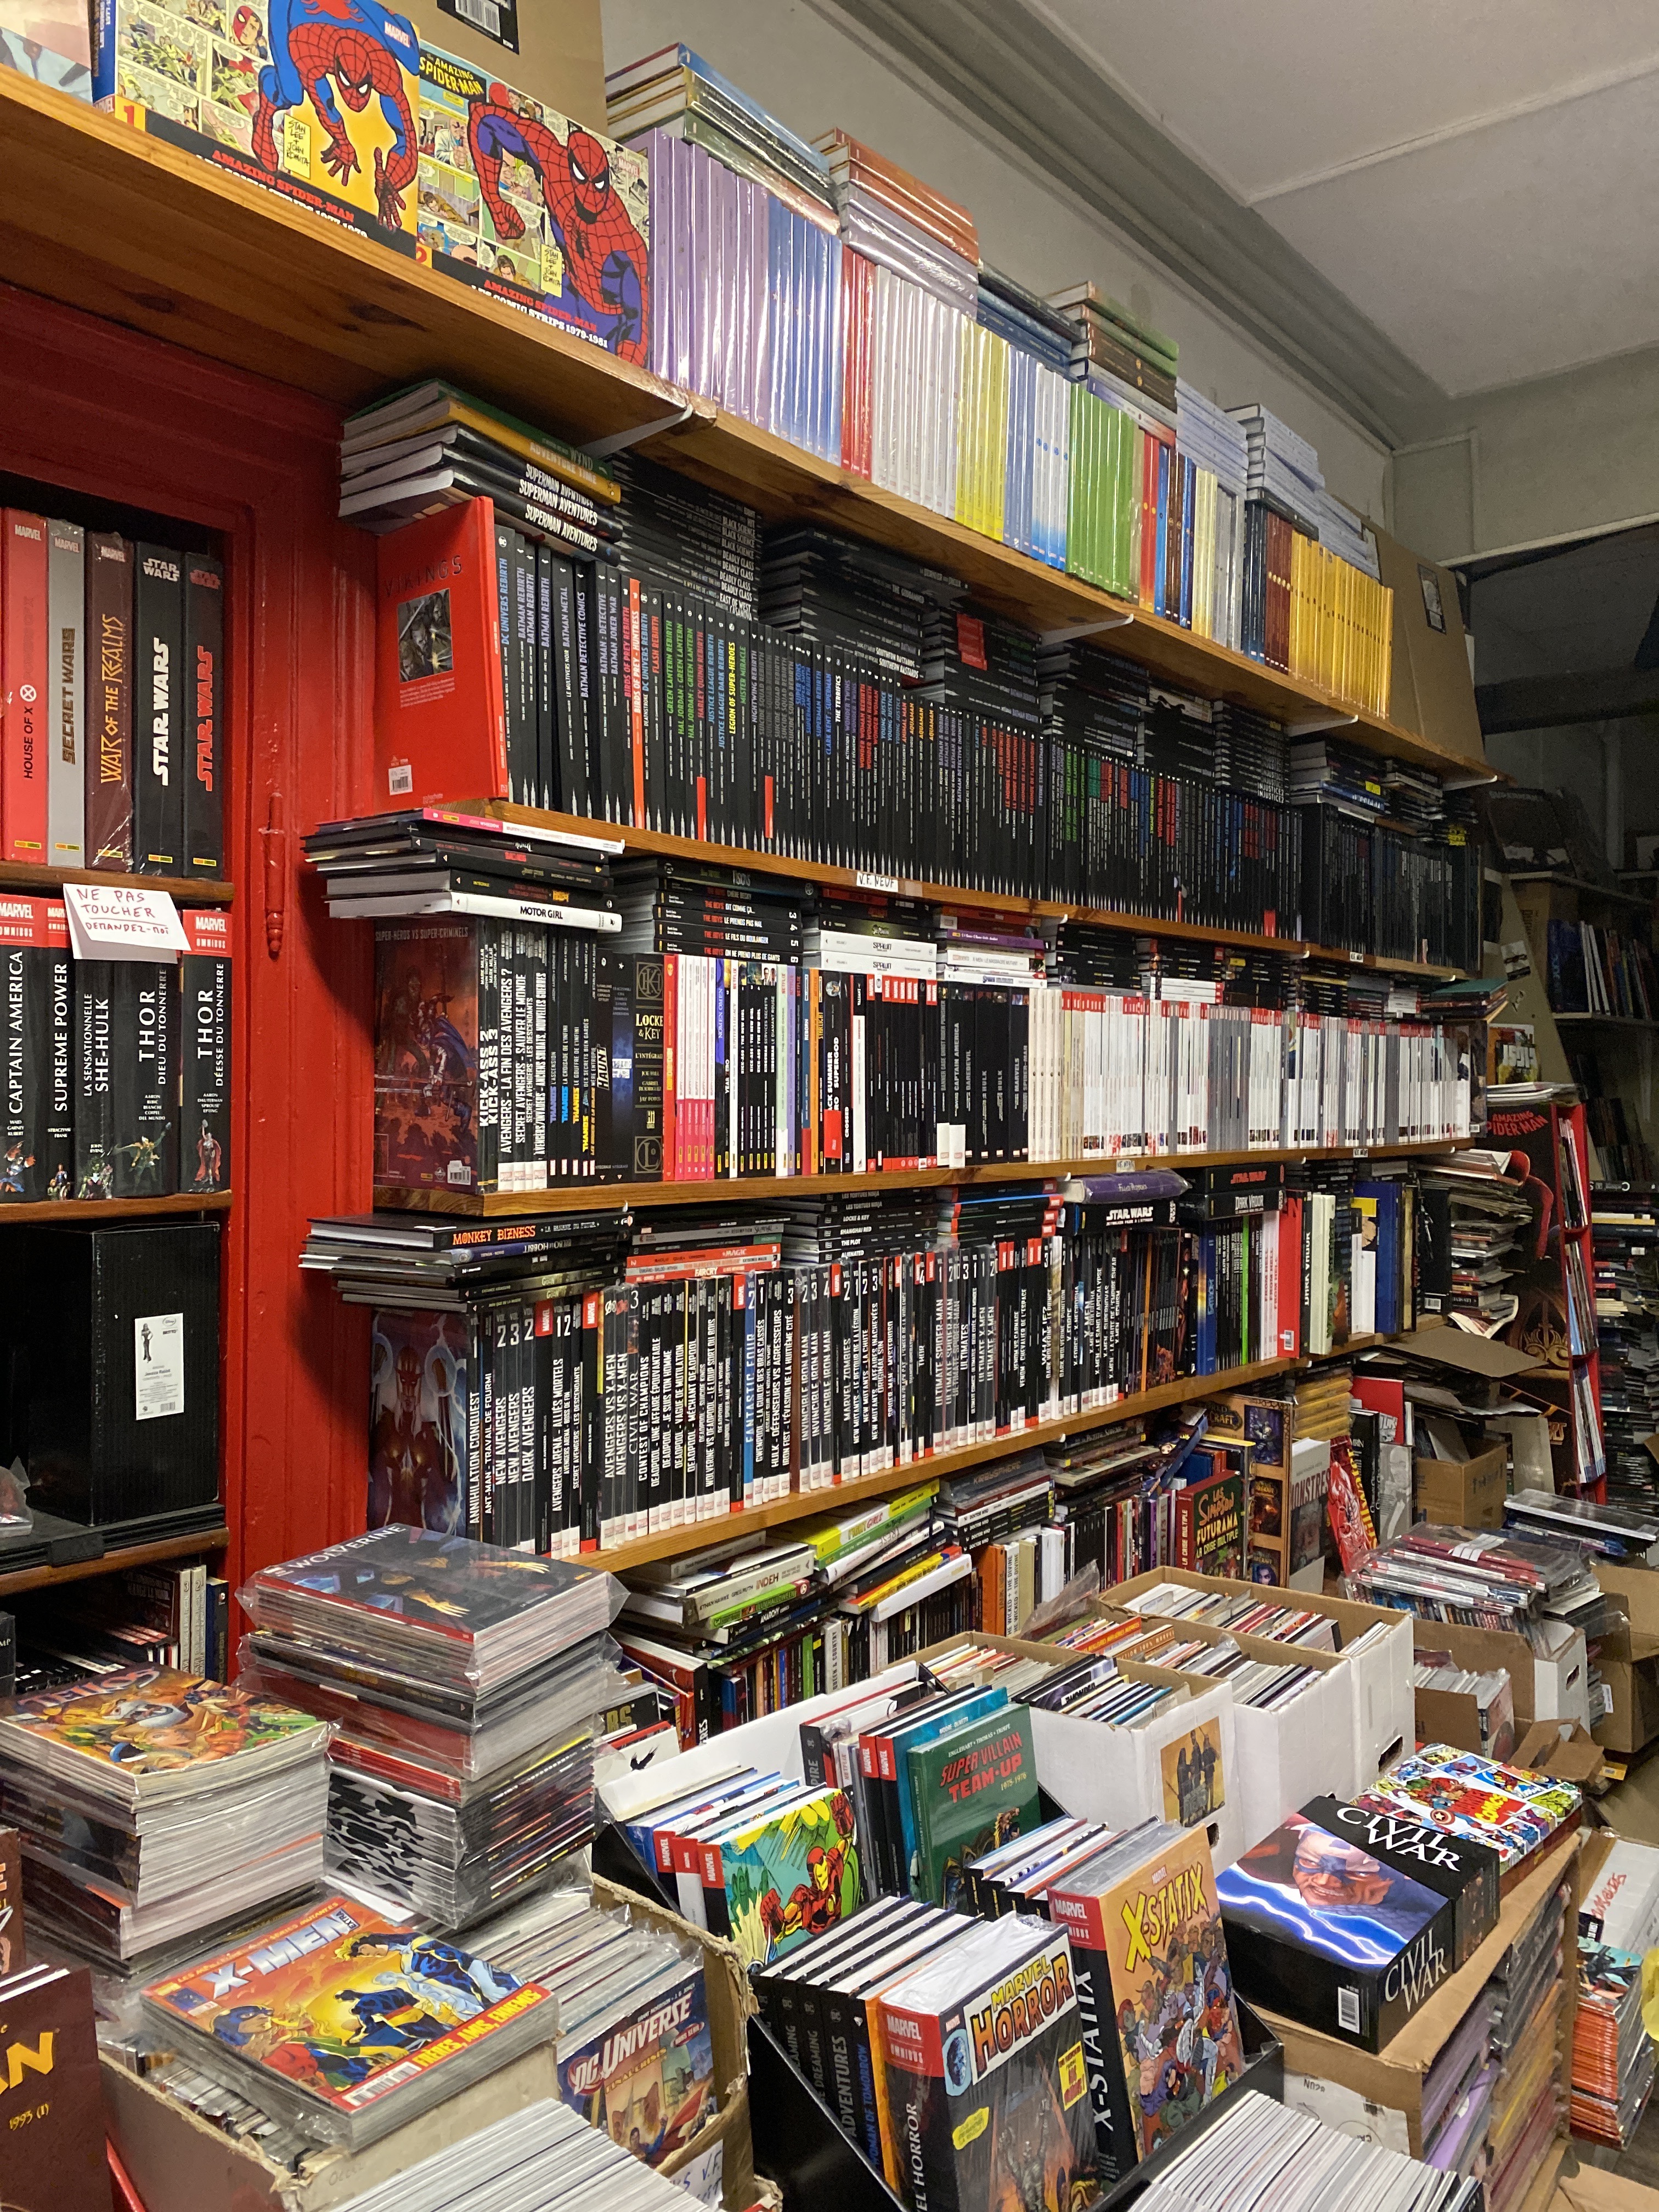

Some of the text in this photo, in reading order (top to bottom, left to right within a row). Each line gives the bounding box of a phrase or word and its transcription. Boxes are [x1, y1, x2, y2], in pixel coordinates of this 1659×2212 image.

[384, 22, 410, 48] MARVEL
[419, 57, 484, 95] SPIDER-MAN
[435, 57, 473, 80] AMAZING
[124, 105, 134, 127] 1
[288, 120, 306, 134] STAN
[287, 142, 304, 154] JOHN
[291, 131, 304, 140] LEE
[286, 151, 310, 166] ROMITA
[618, 156, 640, 177] MARVEL
[212, 150, 275, 185] AMAZING
[276, 179, 354, 223] SPIDER-MAN
[484, 279, 533, 306] AMAZING
[535, 300, 597, 332] SPIDER-MAN
[528, 309, 608, 349] STRIPS 1979-1981
[530, 442, 597, 485] ADVENTURE TIME
[571, 447, 593, 471] WYND
[526, 464, 560, 493] SUPERMAN
[519, 479, 598, 526] SUPERMAN AVENTURES
[14, 524, 42, 541] MARVEL
[526, 504, 598, 552] SUPERMAN AVENTURES
[54, 537, 80, 554] MARVEL
[101, 545, 126, 563] MARVEL
[143, 558, 179, 574] STAR
[143, 565, 180, 582] WARS
[385, 555, 462, 597] VIKINGS
[721, 582, 752, 602] DEADLY CLASS
[577, 592, 589, 698] BATMAN DETECTIVE COMICS
[632, 610, 640, 652] HUNTRESS
[633, 658, 641, 675] PREY
[633, 676, 640, 689] OF
[61, 628, 76, 765] SECRET WARS
[100, 614, 125, 784] WAR OF THE REALMS
[153, 637, 170, 786] STAR WARS
[729, 698, 735, 707] OF
[196, 645, 213, 792] STAR WARS
[24, 707, 34, 779] HOUSE OF X
[76, 888, 145, 902] NE PAS
[859, 874, 894, 888] V.F. NEUF
[81, 904, 156, 919] TOUCHER
[195, 917, 227, 933] MARVEL
[520, 906, 563, 920] MOTOR GIRL
[196, 938, 226, 949] OMNIBUS
[412, 929, 419, 940] VS
[420, 927, 469, 939] SUPER-CRIMINELS
[9, 951, 22, 1114] CAPTAIN AMERICA
[139, 991, 156, 1062] THOR
[158, 969, 167, 1085] DIEU DU TONNERRE
[197, 990, 213, 1059] THOR
[214, 963, 224, 1086] DÉESSE DU TONNERRE
[635, 1014, 663, 1026] LOCKE
[639, 1027, 661, 1040] & KEY
[54, 963, 67, 1112] SUPREME POWER
[83, 993, 92, 1096] LA SENSATIONNELLE
[95, 998, 109, 1092] SHE-HULK
[479, 1030, 489, 1126] KICK-ASS 2
[500, 978, 512, 1153] AVENGERS LA FIN DES AVENGERS
[597, 1044, 609, 1090] HAUNT
[1487, 1115, 1548, 1137] PIDER-MAN
[1492, 1110, 1534, 1122] AMAZING
[1106, 1206, 1153, 1221] STAR WARS
[1235, 1194, 1263, 1210] DARK VADOR
[453, 1225, 536, 1245] MONKEY BIZNESS
[522, 1386, 534, 1482] DARK AVENGERS
[470, 1392, 480, 1523] ANNIHILATION CONQUEST
[1198, 1492, 1234, 1526] SIMPSON
[1197, 1511, 1238, 1546] FUTURAMA
[1204, 1539, 1216, 1555] CRISE
[1217, 1528, 1239, 1548] MULTIPLE
[287, 1526, 407, 1569] WOLVERINE
[756, 1574, 779, 1591] INDEH
[760, 1606, 780, 1624] ANARCHY
[976, 1732, 994, 1744] THOMAS
[996, 1723, 1011, 1735] TRIMPE
[940, 1731, 1022, 1787] SUPER-VILLAIN
[949, 1753, 1022, 1803] TEAM-UP
[1474, 1793, 1509, 1824] COMICS
[1337, 1807, 1449, 1852] CIVIL
[660, 1838, 671, 1866] MARVEL
[1368, 1827, 1460, 1871] WAR
[705, 1852, 716, 1882] MARVEL
[1152, 1865, 1167, 1886] MARVEL
[1054, 1899, 1087, 1919] MARVEL
[1121, 1861, 1210, 1973] X-STATIX
[201, 1915, 352, 2000] X-MEN
[335, 1909, 358, 1930] EXTRA
[1385, 1928, 1438, 2002] CIVIL
[991, 1955, 1052, 2012] MARVEL
[1401, 1947, 1448, 2013] WAR
[412, 1989, 542, 2067] FRÈRES, AMIS, ENNEMIS
[886, 2014, 922, 2041] MARVEL
[970, 1951, 1074, 2079] HORROR
[574, 2053, 600, 2095] DC
[602, 1992, 692, 2080] UNIVERSE
[890, 2044, 923, 2063] OMNIBUS
[831, 2035, 857, 2137] ADVENTURES
[10, 2103, 49, 2131] 1993 (I)
[906, 2103, 924, 2189] HORROR
